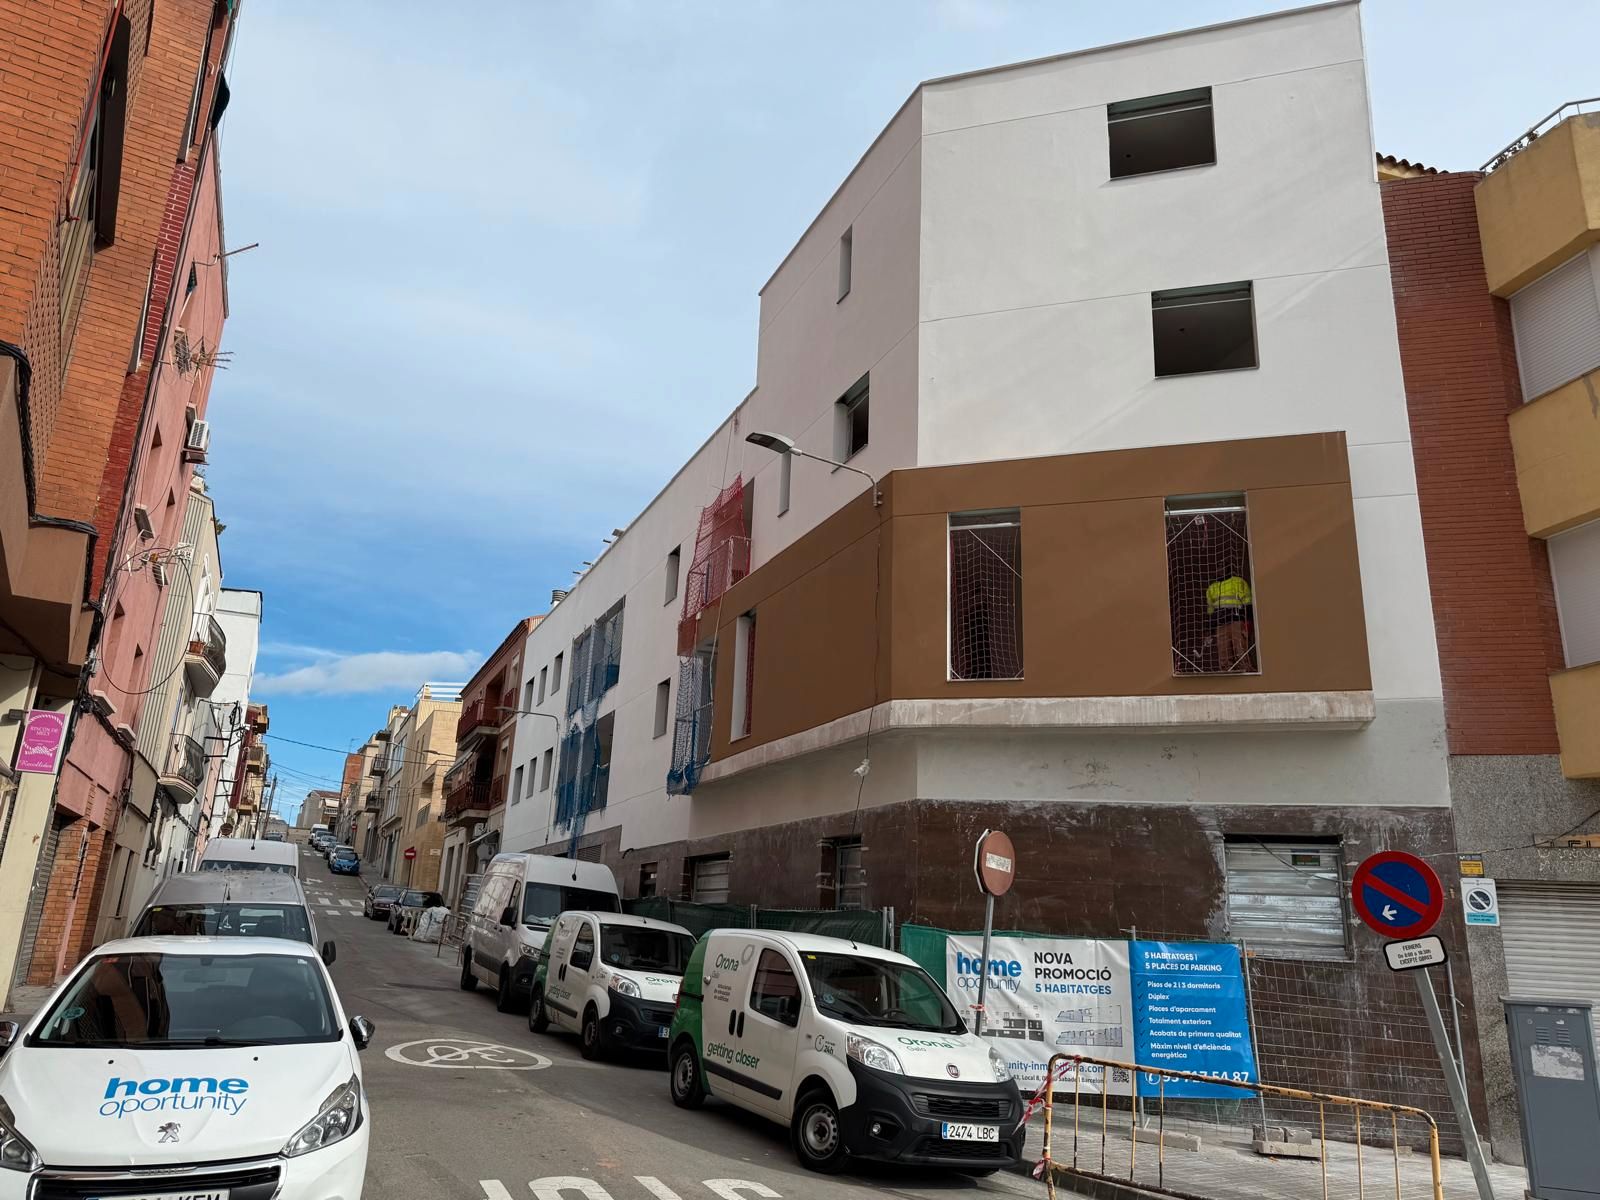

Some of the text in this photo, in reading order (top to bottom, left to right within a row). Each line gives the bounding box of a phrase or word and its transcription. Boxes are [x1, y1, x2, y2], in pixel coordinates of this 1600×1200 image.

[716, 954, 739, 971] Orona
[1034, 952, 1073, 965] NOVA
[1150, 952, 1194, 960] HABITATGES
[957, 952, 1022, 977] home
[645, 976, 681, 984] Oron
[1034, 967, 1112, 980] PROMOCIÓ
[957, 976, 1021, 994] opotunity
[1035, 984, 1112, 995] 5 HABITATGES
[1188, 1031, 1215, 1039] primera
[1216, 1032, 1242, 1040] qualitat
[898, 1036, 954, 1049] Orona
[1193, 1043, 1232, 1052] d'eficiència
[706, 1042, 760, 1070] getting closer
[1152, 1052, 1188, 1060] energètica
[1232, 1072, 1249, 1082] 87
[104, 1077, 249, 1099] home
[100, 1092, 248, 1119] oportunity
[949, 1126, 995, 1140] 2474 LBC
